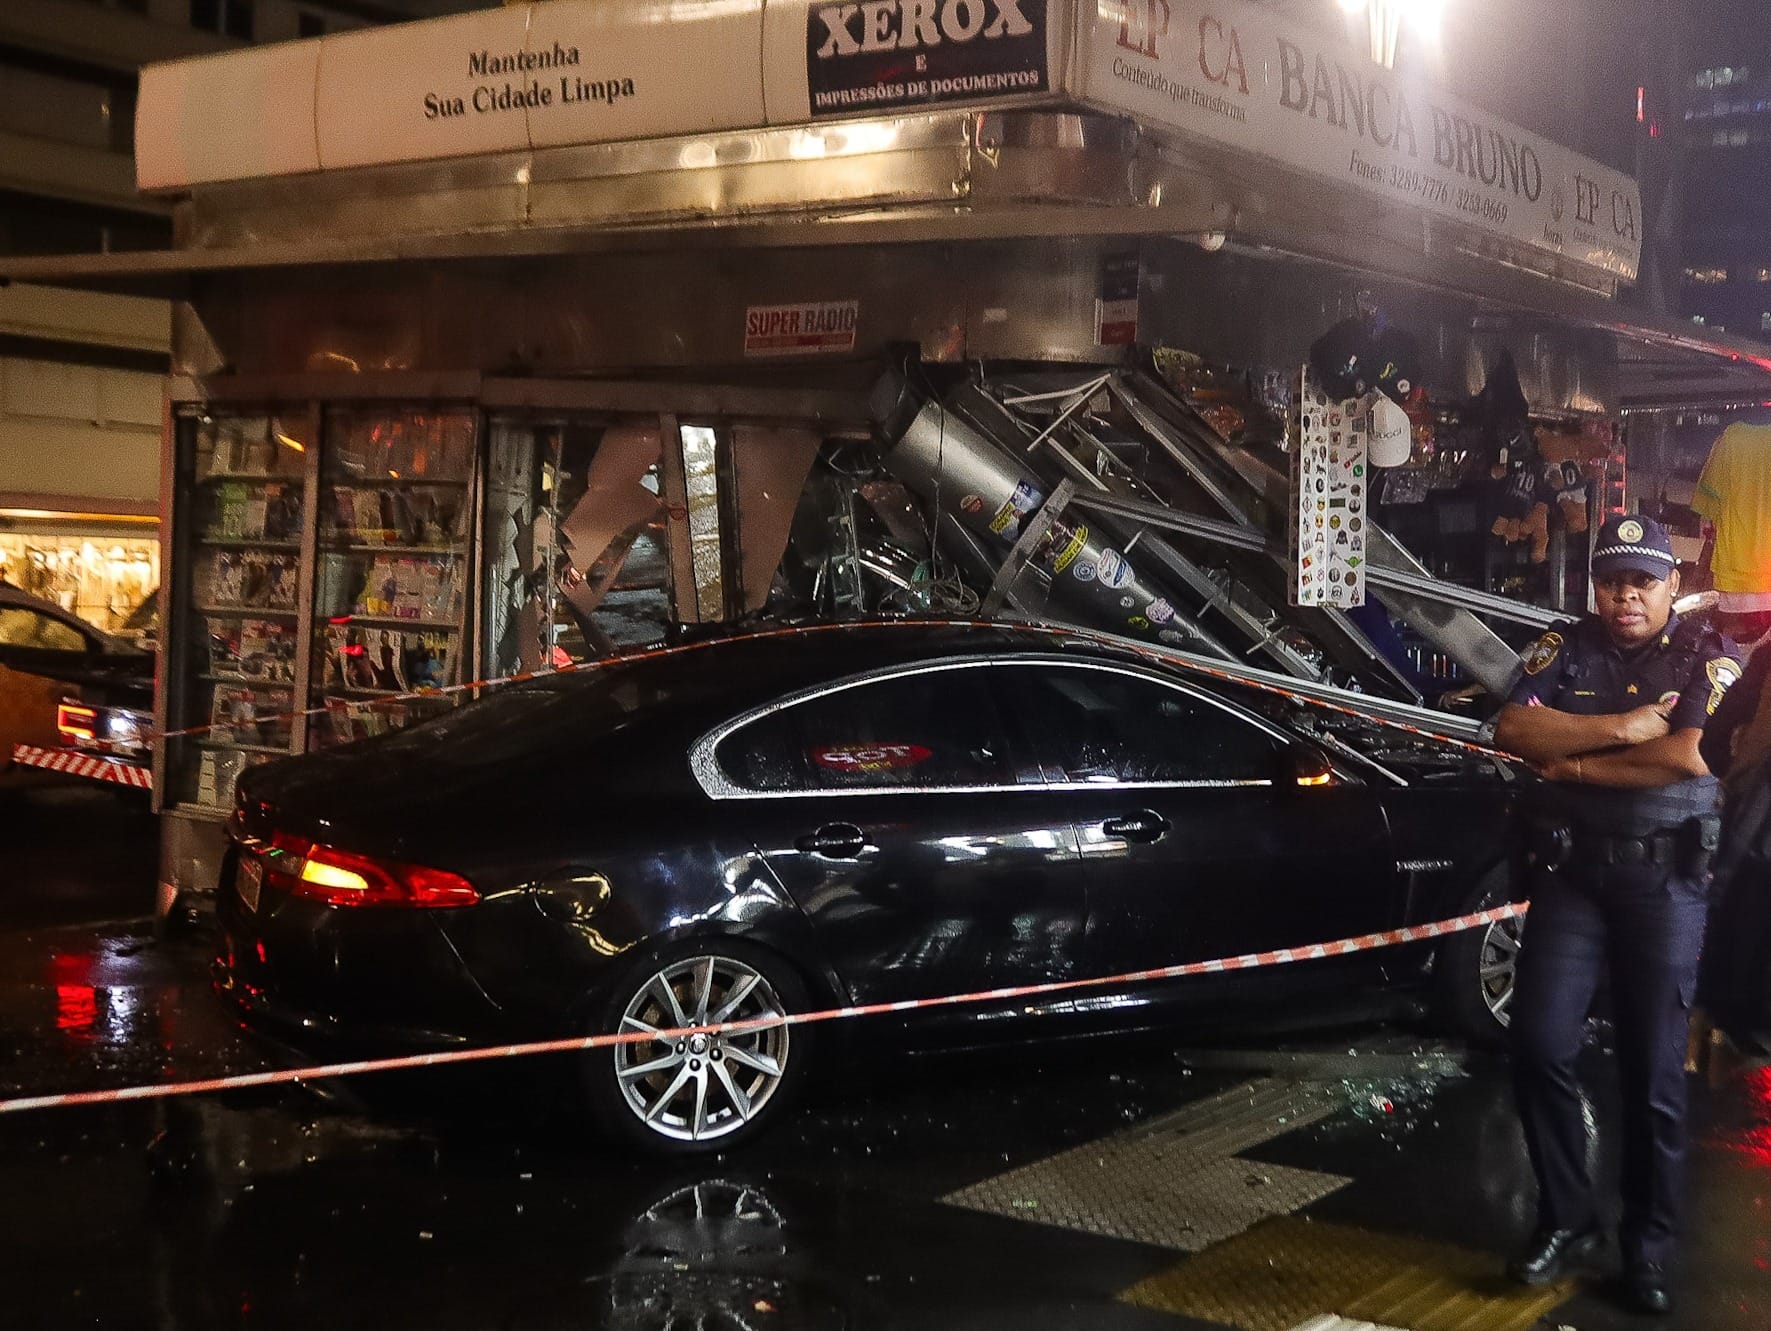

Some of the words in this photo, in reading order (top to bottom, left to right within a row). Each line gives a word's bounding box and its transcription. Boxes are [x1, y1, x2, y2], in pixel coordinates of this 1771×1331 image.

[817, 0, 1033, 57] XEROX
[468, 40, 580, 78] Mantenha
[914, 54, 928, 73] E
[423, 91, 465, 120] Sua
[472, 80, 552, 114] Cidade
[560, 75, 635, 105] Limpa
[815, 81, 905, 107] IMPRESSÕES
[907, 83, 928, 97] DE
[930, 69, 1039, 94] DOCUMENTOS
[1277, 36, 1418, 158] BANCA
[1432, 104, 1541, 201] BRUNO
[748, 310, 800, 337] SUPER
